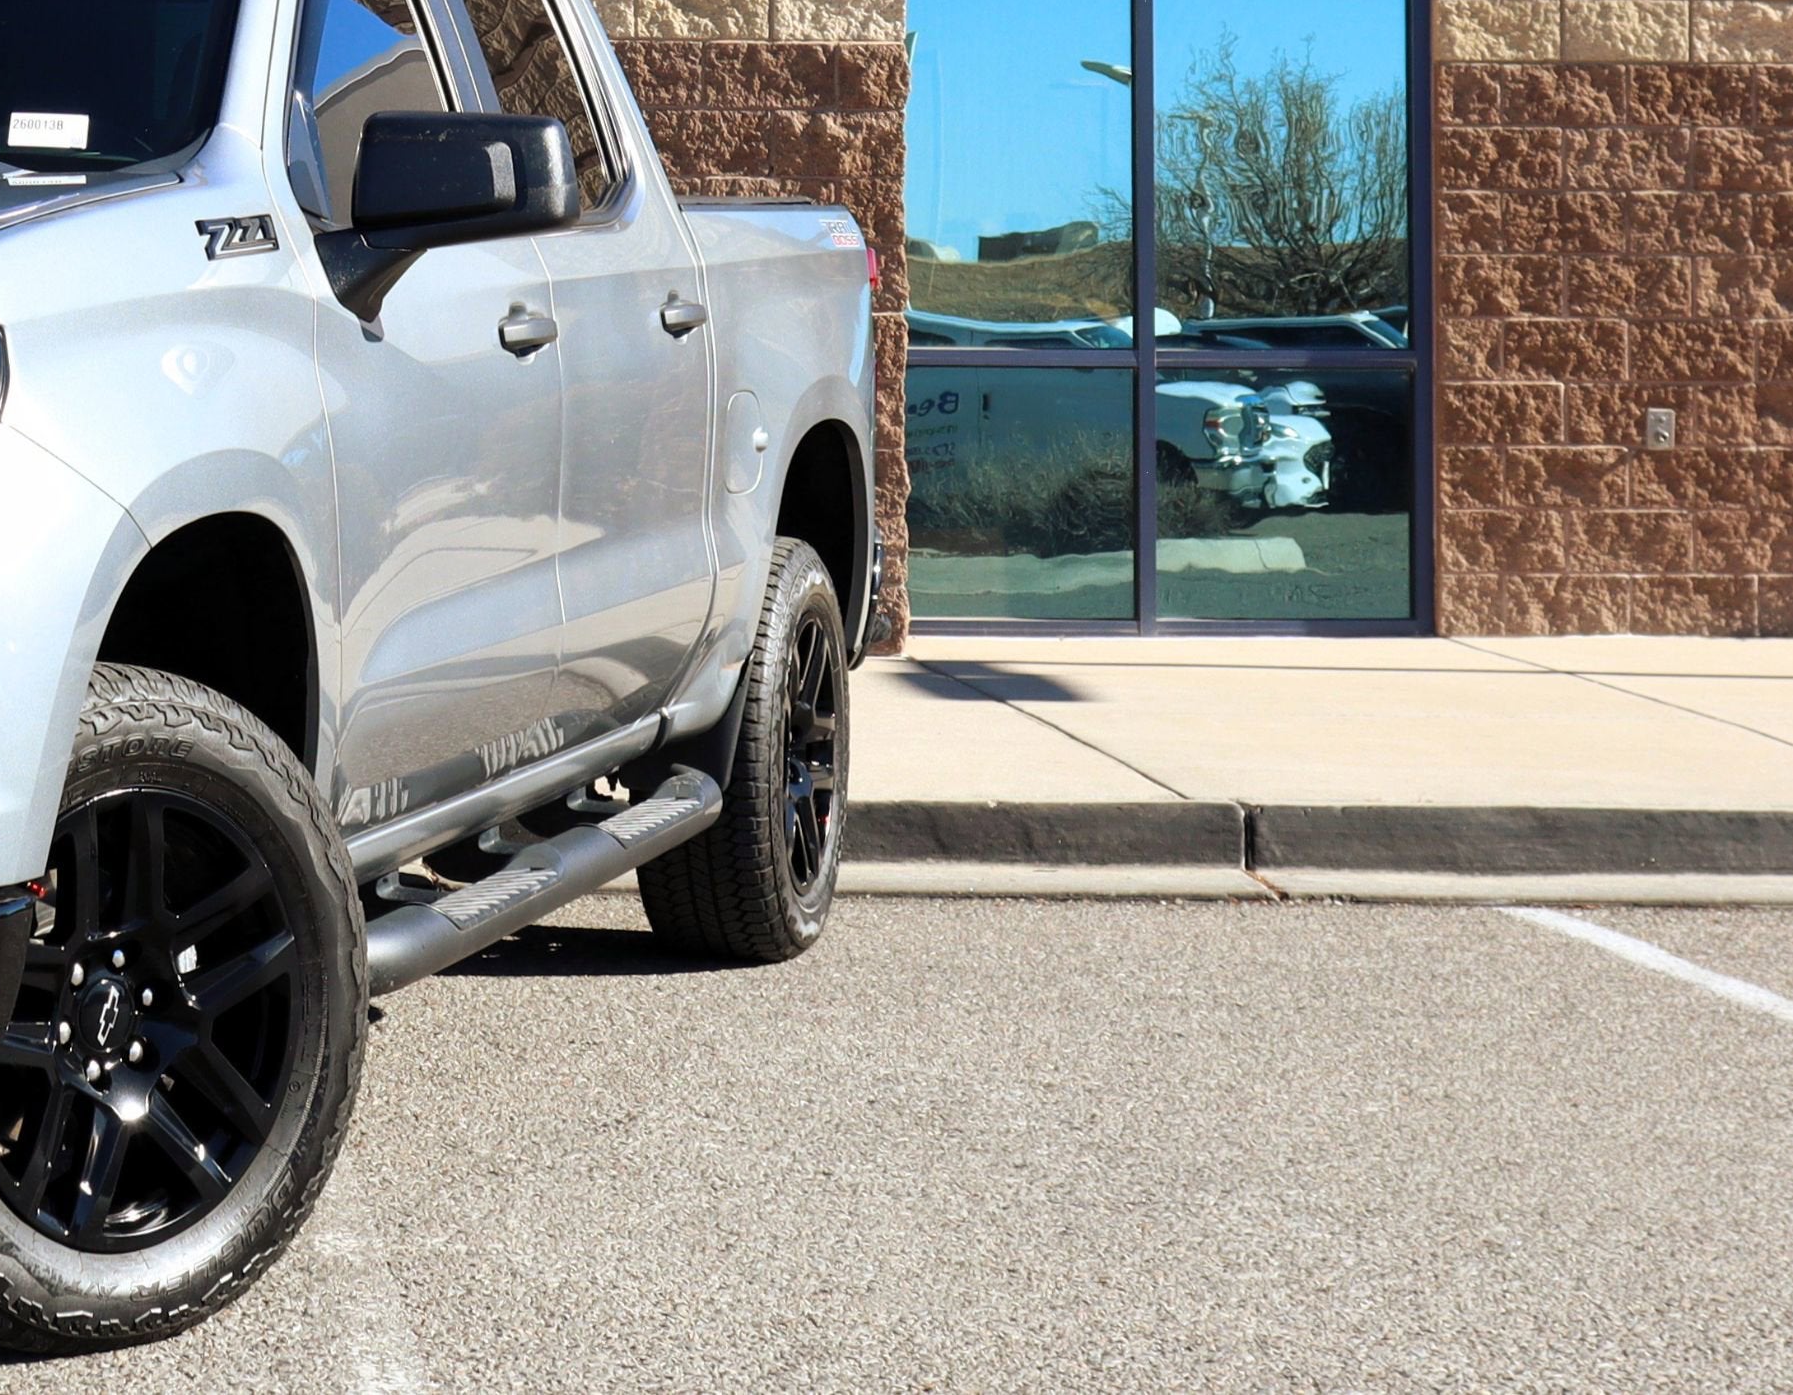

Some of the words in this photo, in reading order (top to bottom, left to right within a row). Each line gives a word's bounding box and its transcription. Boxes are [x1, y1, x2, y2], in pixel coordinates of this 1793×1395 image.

[194, 213, 280, 261] Z71
[820, 220, 858, 235] TRAIL
[70, 732, 195, 774] STONE
